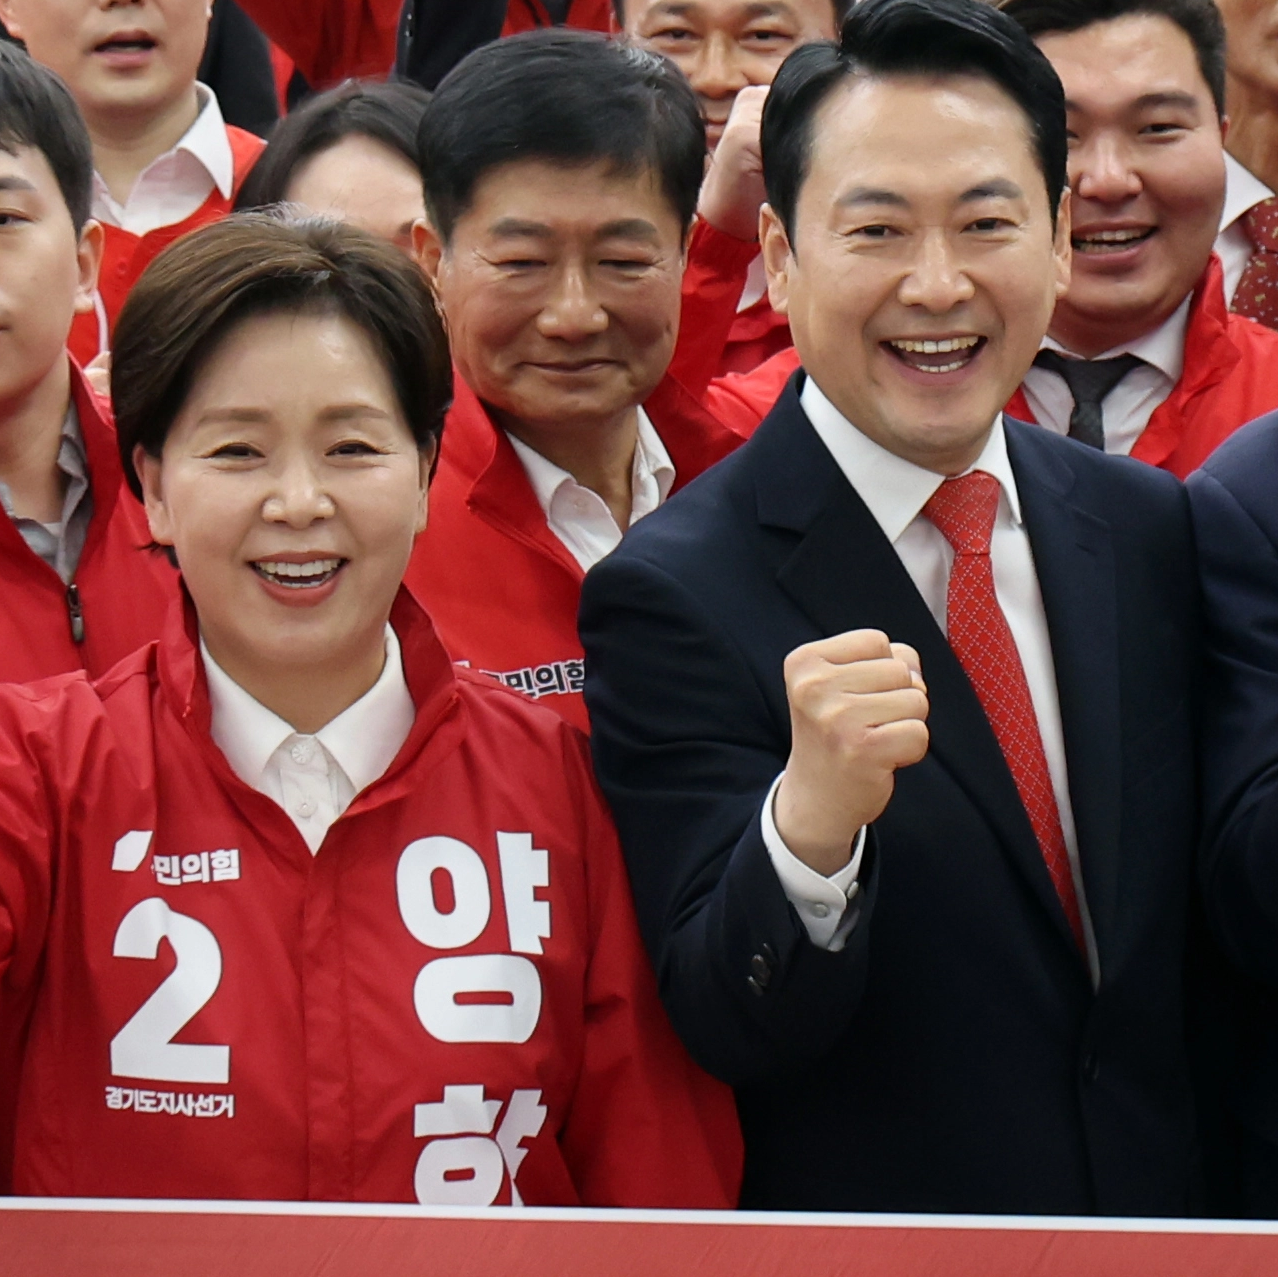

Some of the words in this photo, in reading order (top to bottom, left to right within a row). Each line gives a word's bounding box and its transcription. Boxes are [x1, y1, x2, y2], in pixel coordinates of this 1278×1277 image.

[479, 659, 585, 700] 민의힘
[150, 848, 241, 886] 민의힘
[109, 896, 231, 1085] 2
[105, 1085, 234, 1119] 경기도지사선거
